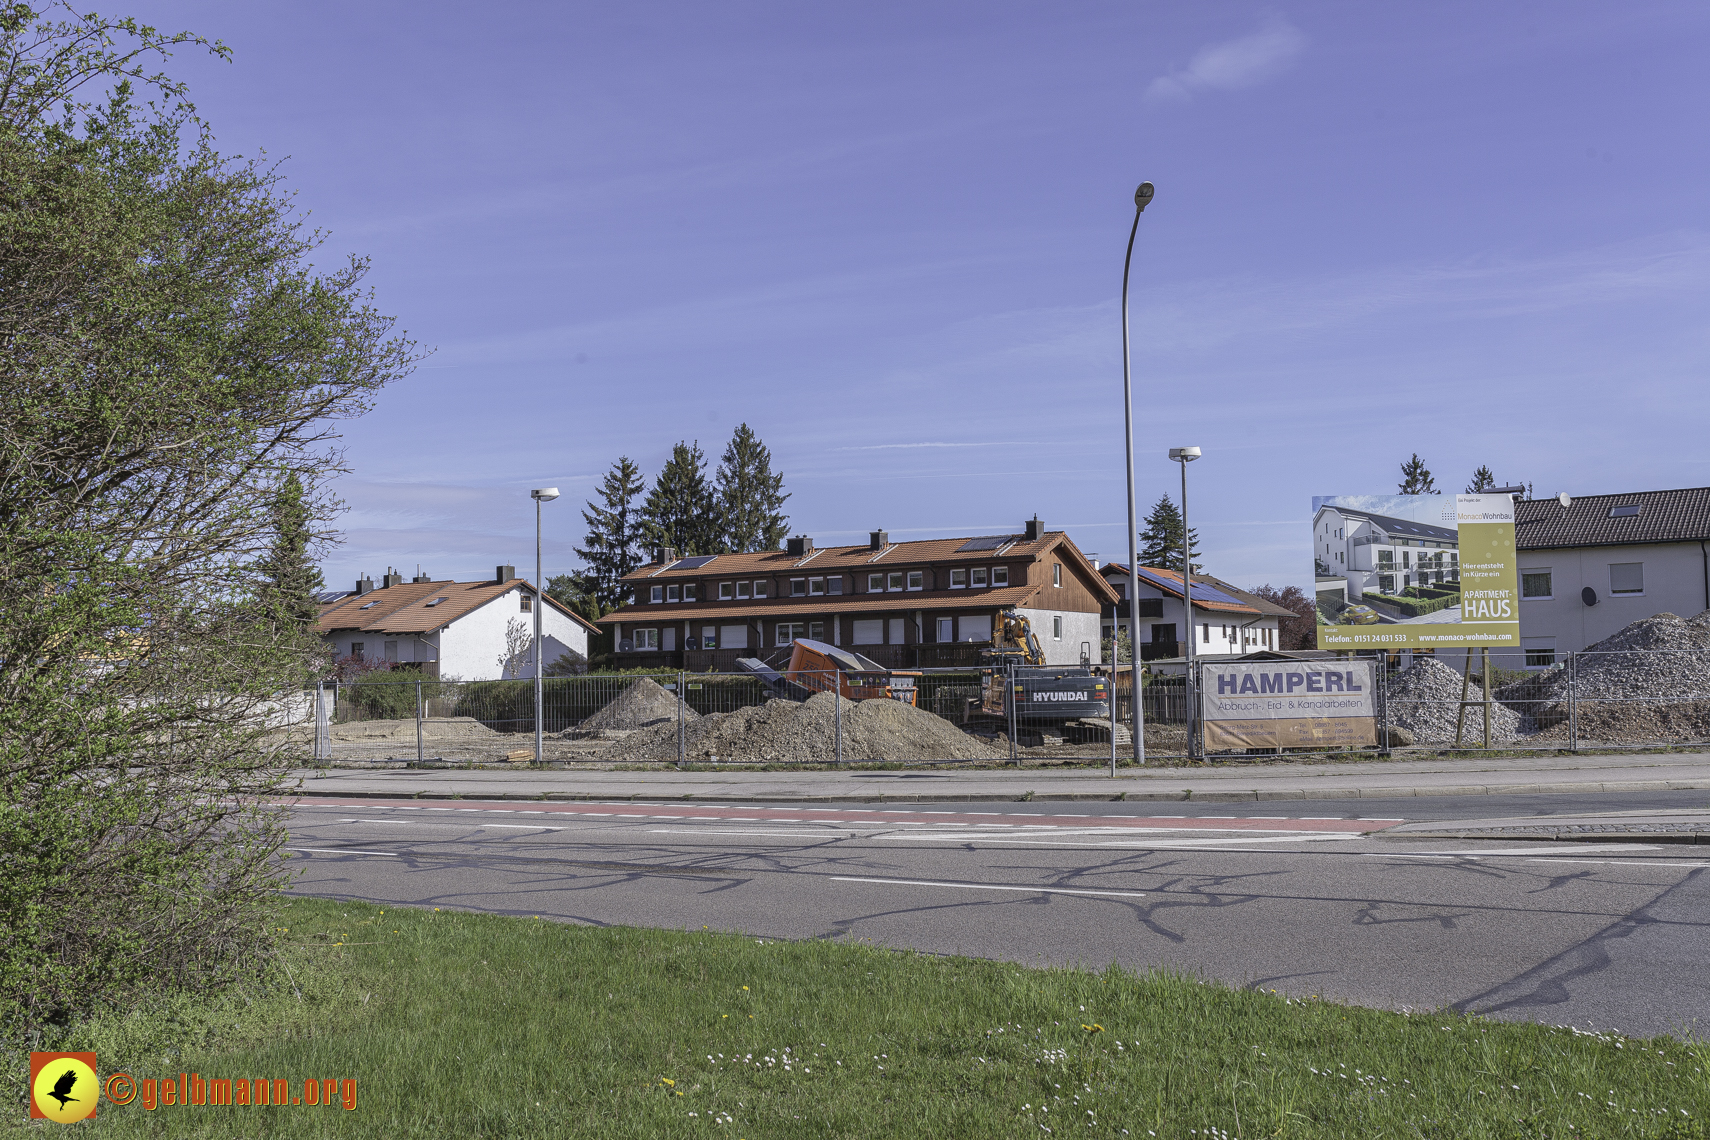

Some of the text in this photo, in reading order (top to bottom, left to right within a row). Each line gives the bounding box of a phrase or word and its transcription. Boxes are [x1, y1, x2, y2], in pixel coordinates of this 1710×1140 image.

[1464, 590, 1512, 599] APARTMENT-
[1464, 599, 1511, 618] HAUS
[1324, 635, 1352, 643] Telefon:
[1381, 634, 1393, 642] 031
[1394, 634, 1407, 642] 533
[1418, 632, 1512, 642] www.monaco-wohnbau.com
[1217, 671, 1362, 695] HAMPERL
[1033, 691, 1088, 702] HYUNDAI
[1218, 700, 1363, 711] Abbruch-, Erd- & Kanalarbeiten
